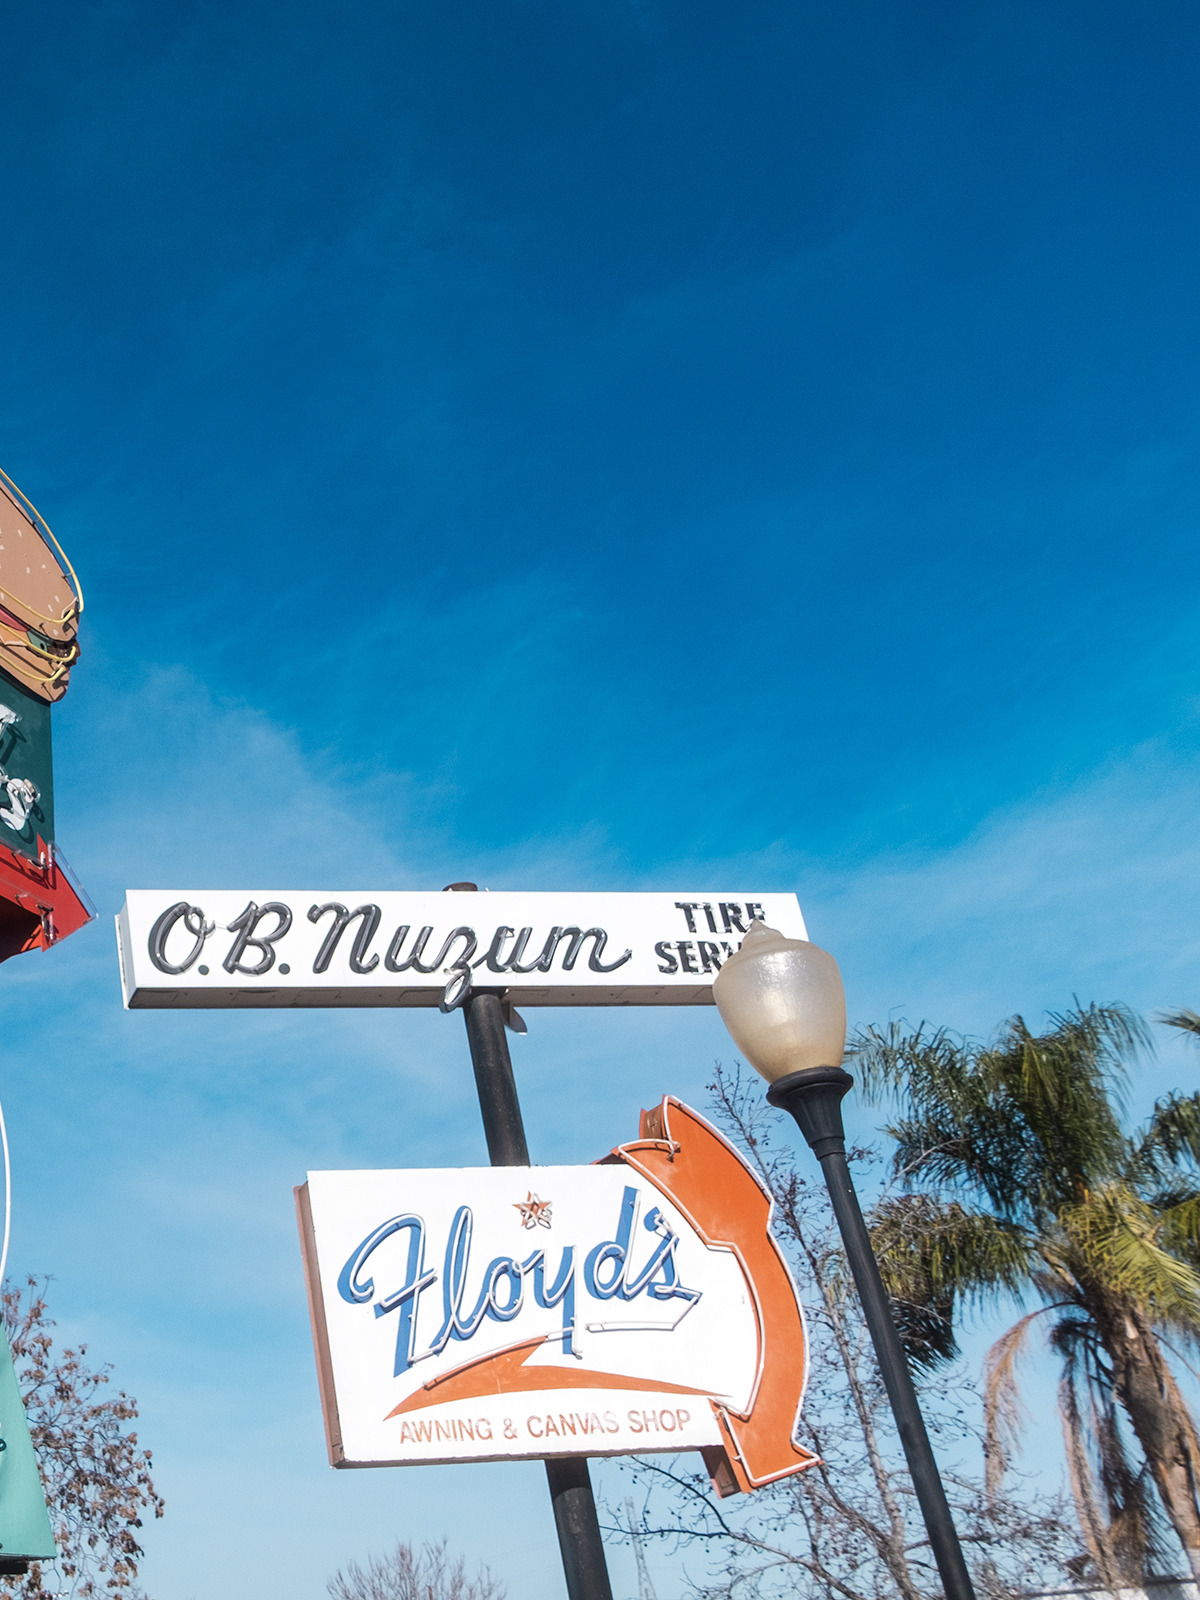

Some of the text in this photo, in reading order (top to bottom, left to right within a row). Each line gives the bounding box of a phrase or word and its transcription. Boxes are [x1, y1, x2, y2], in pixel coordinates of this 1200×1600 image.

[674, 902, 766, 934] TIRE
[307, 901, 632, 1014] Nuzum
[654, 940, 743, 976] SERV
[337, 1186, 703, 1378] Floyd's
[400, 1408, 691, 1445] AWNING & CANVAS SHOP
